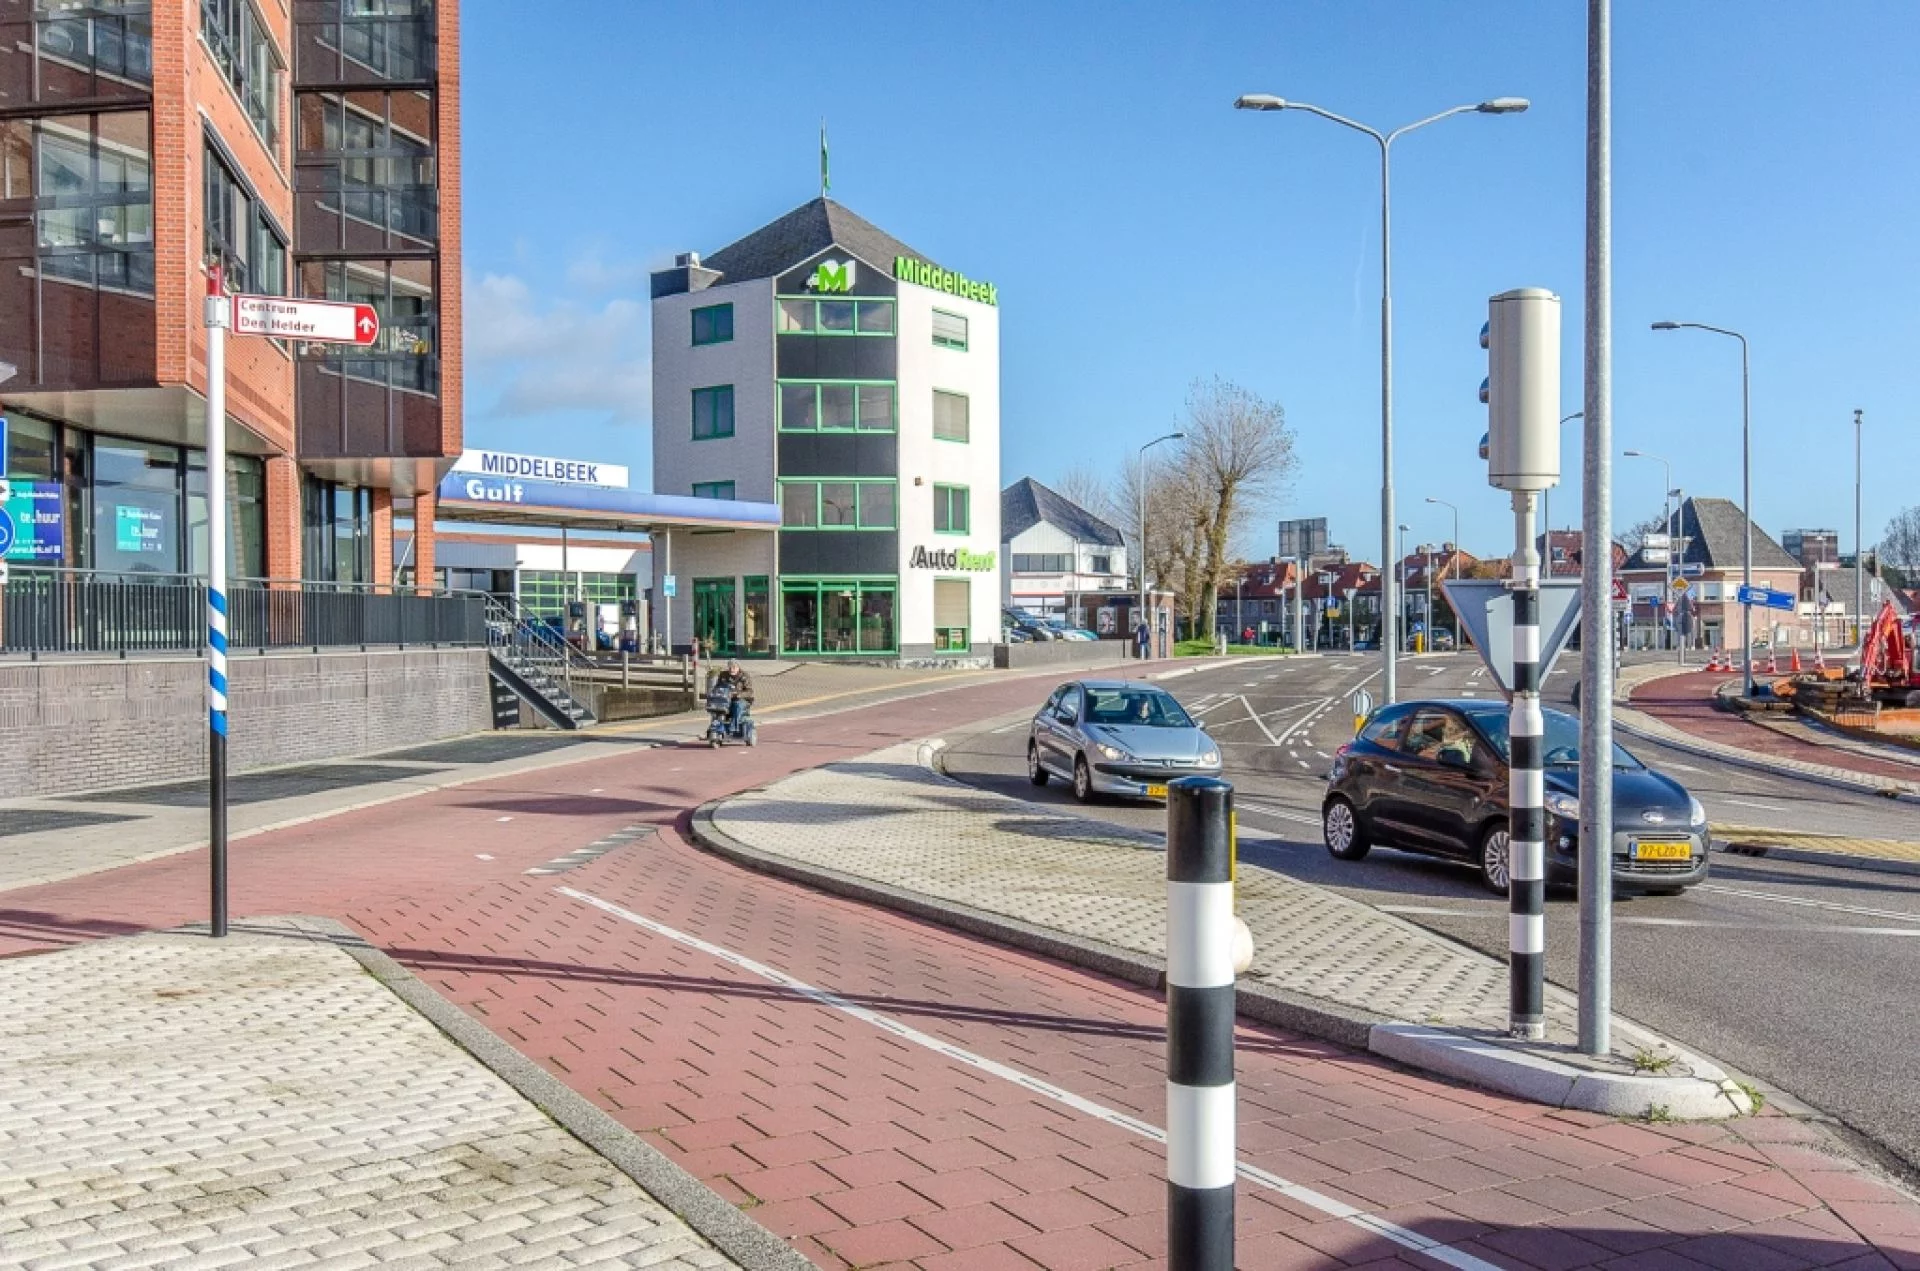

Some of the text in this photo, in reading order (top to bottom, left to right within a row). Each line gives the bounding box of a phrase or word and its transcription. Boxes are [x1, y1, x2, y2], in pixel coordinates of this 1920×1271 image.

[894, 256, 998, 306] Middelbeek
[241, 301, 297, 315] Centrum
[241, 317, 316, 333] Den Helder
[481, 452, 598, 483] MIDDELBEEK
[465, 479, 525, 503] Gulf
